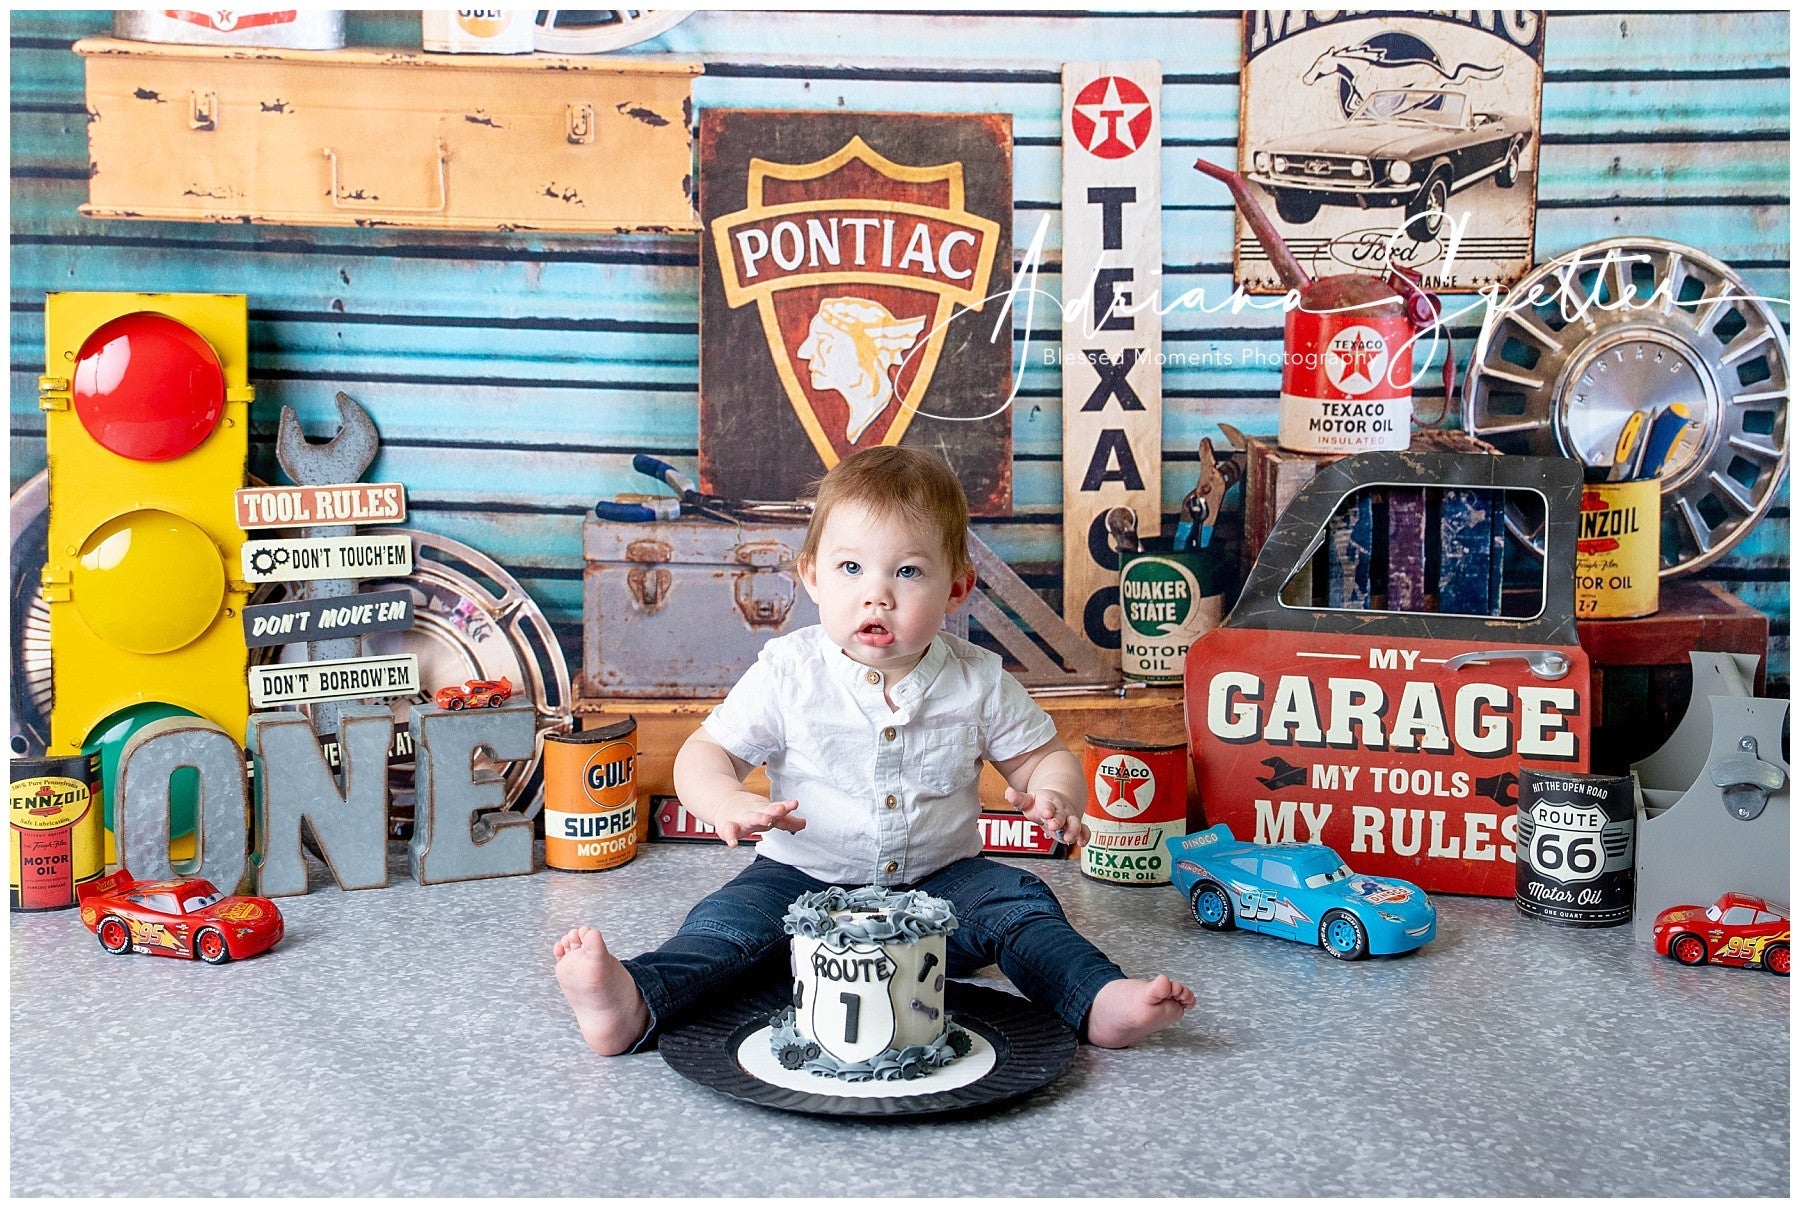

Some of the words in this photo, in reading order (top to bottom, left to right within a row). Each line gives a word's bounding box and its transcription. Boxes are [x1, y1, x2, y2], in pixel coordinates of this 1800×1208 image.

[735, 217, 976, 280] PONTIAC
[1352, 232, 1418, 261] Ford
[1335, 340, 1383, 349] TEXACO
[1322, 403, 1384, 417] TEXACO
[1309, 419, 1366, 433] MOTOR
[1373, 419, 1393, 433] OIL
[1318, 436, 1384, 445] INSULATED
[244, 492, 310, 523] TOOL
[314, 488, 399, 520] RULES
[1578, 507, 1639, 539] NZOIL
[292, 548, 331, 569] DON'T
[339, 545, 406, 567] TOUCH'EM
[1124, 580, 1187, 599] QUAKER
[1575, 576, 1603, 589] TOR
[1609, 576, 1632, 589] OIL
[252, 611, 311, 637] DON'T
[318, 600, 407, 628] MOVE'EM
[1130, 602, 1176, 621] STATE
[1126, 644, 1188, 656] MOTOR
[1369, 648, 1420, 671] MY
[1140, 659, 1171, 670] OIL
[263, 673, 309, 696] DON'T
[320, 666, 410, 691] BORROW'EM
[1207, 671, 1579, 760] GARAGE
[588, 756, 634, 791] GULF
[1101, 765, 1149, 777] TEXACO
[1312, 764, 1360, 791] MY
[1369, 767, 1470, 798] TOOLS
[10, 788, 89, 810] ENNZOIL
[114, 700, 538, 898] ONE
[1533, 782, 1544, 793] HIT
[1545, 782, 1560, 791] THE
[1562, 782, 1585, 793] OPEN
[1586, 785, 1608, 800] ROAD
[1539, 809, 1598, 827] ROUTE
[977, 818, 1039, 848] TIME
[1094, 828, 1150, 851] Improved
[1181, 833, 1218, 850] DINOCO
[1253, 799, 1333, 845] MY
[1351, 805, 1517, 864] RULES
[578, 838, 626, 857] MOTOR
[1536, 833, 1597, 873] 66
[24, 854, 69, 865] MOTOR
[37, 866, 57, 875] OIL
[1088, 849, 1162, 871] TEXACO
[1090, 866, 1130, 880] MOTOR
[1136, 871, 1156, 880] OIL
[1528, 881, 1575, 903] Motor
[1577, 888, 1602, 905] Oil
[1240, 889, 1278, 922] 95
[1544, 908, 1557, 916] ONE
[1559, 911, 1583, 919] QUART
[140, 923, 165, 945] 95
[1727, 936, 1757, 959] 95
[812, 953, 892, 982] ROUTE
[840, 992, 861, 1044] 1
